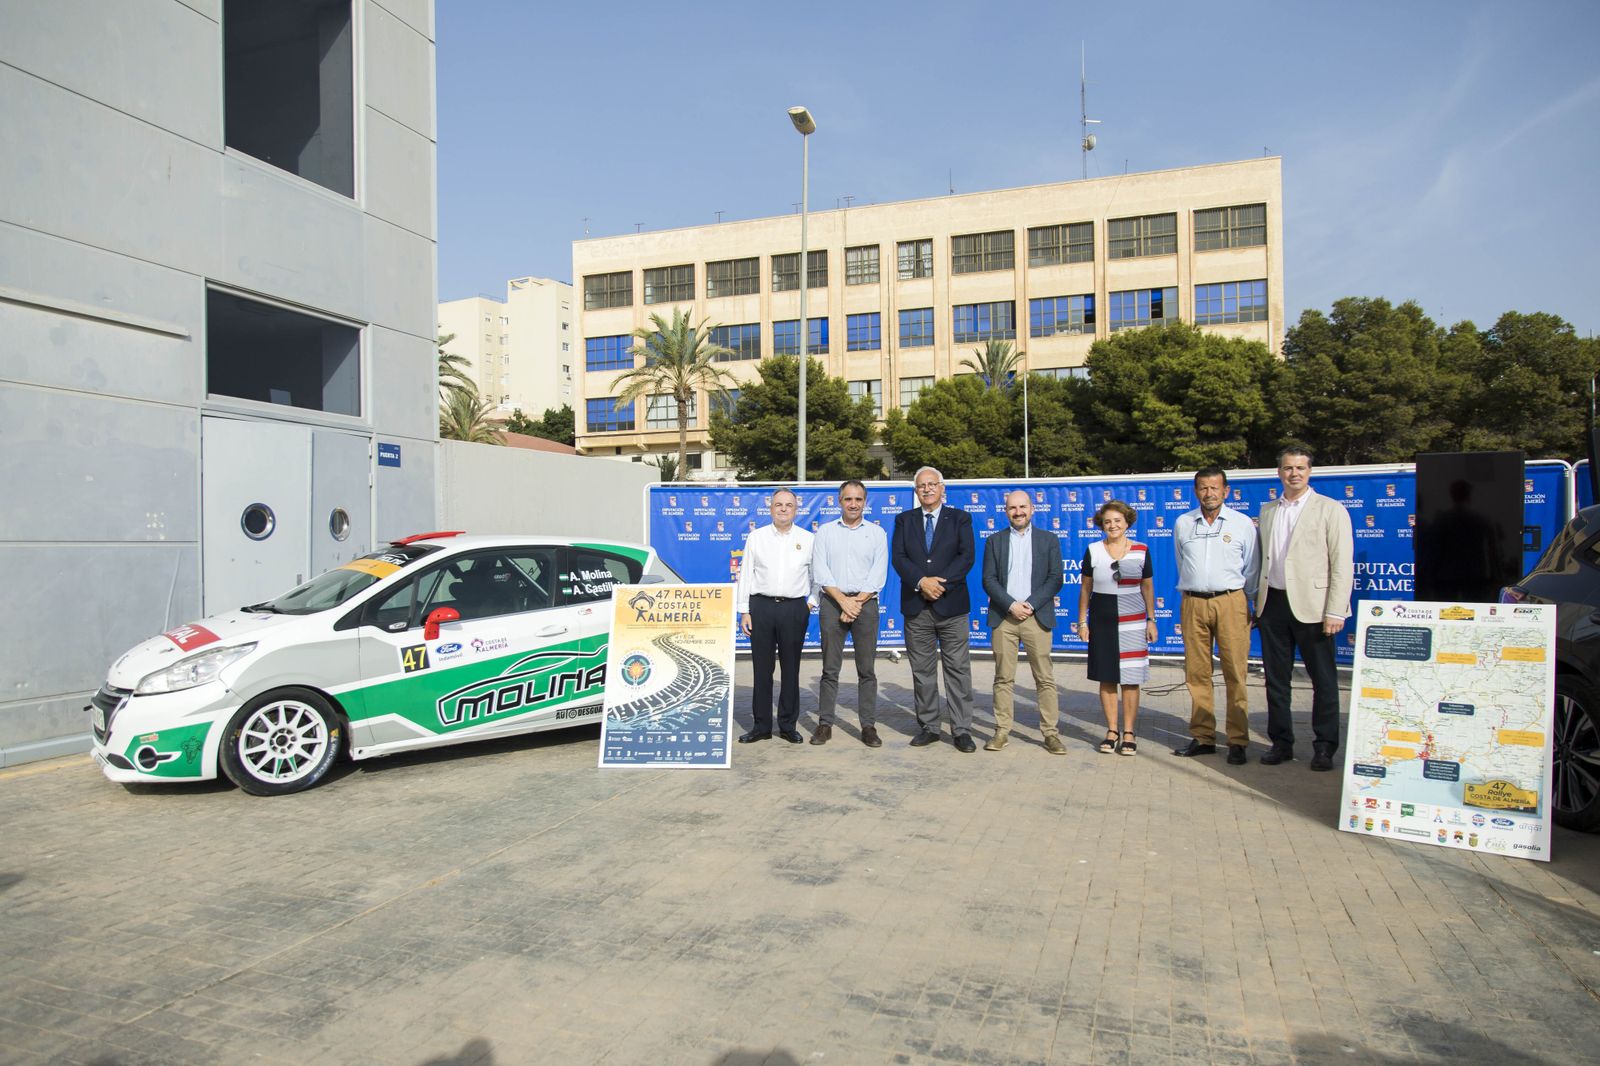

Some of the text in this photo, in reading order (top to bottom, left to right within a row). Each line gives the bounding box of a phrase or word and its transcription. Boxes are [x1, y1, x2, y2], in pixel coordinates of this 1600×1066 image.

[570, 570, 612, 582] A. Molina
[574, 585, 583, 595] A.
[1366, 579, 1415, 591] ALME
[656, 589, 722, 599] 47 RALLYE
[648, 610, 702, 622] ALMERÍA
[480, 643, 508, 652] ALMERÍA
[404, 646, 426, 670] 47
[456, 663, 606, 722] MOLINA
[1513, 843, 1541, 852] gasolia
